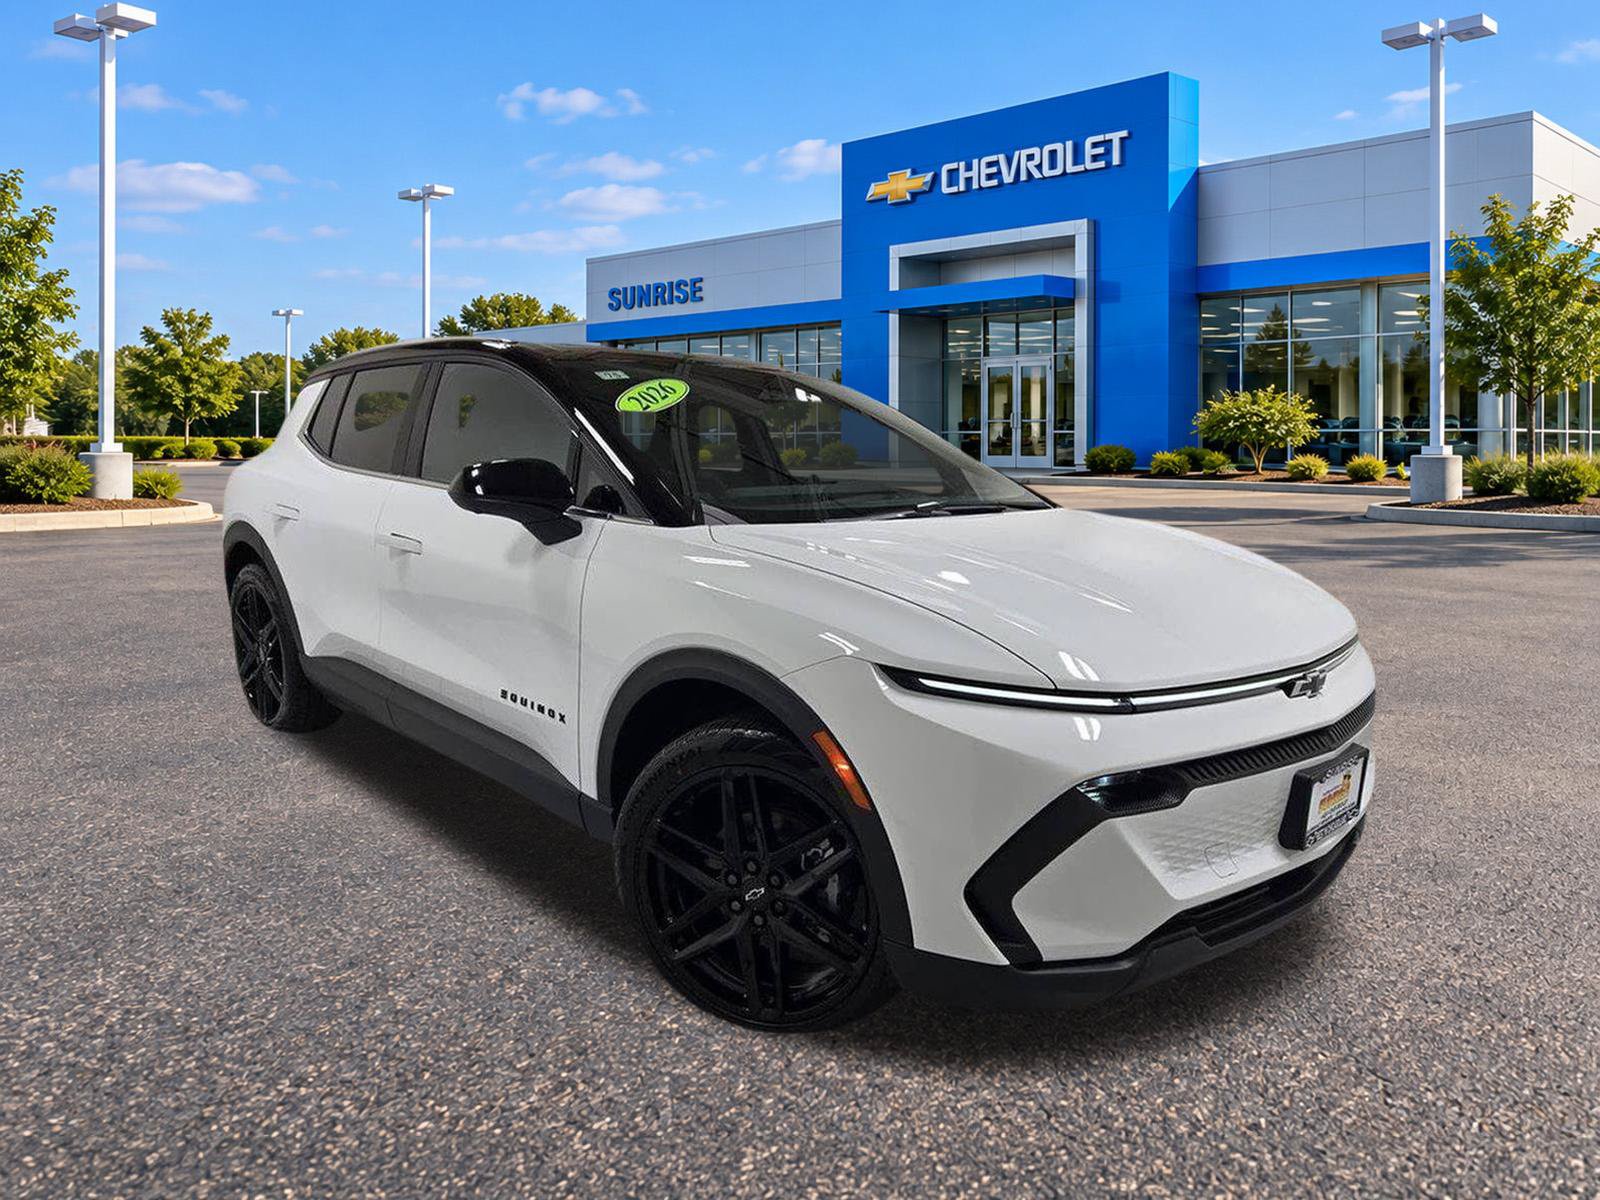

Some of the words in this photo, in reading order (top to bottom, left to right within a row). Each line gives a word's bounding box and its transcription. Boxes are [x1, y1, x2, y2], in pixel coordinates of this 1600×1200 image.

[941, 130, 1129, 194] CHEVROLET
[607, 277, 704, 312] SUNRISE
[627, 381, 677, 411] 2026
[500, 689, 566, 725] EQUINOX
